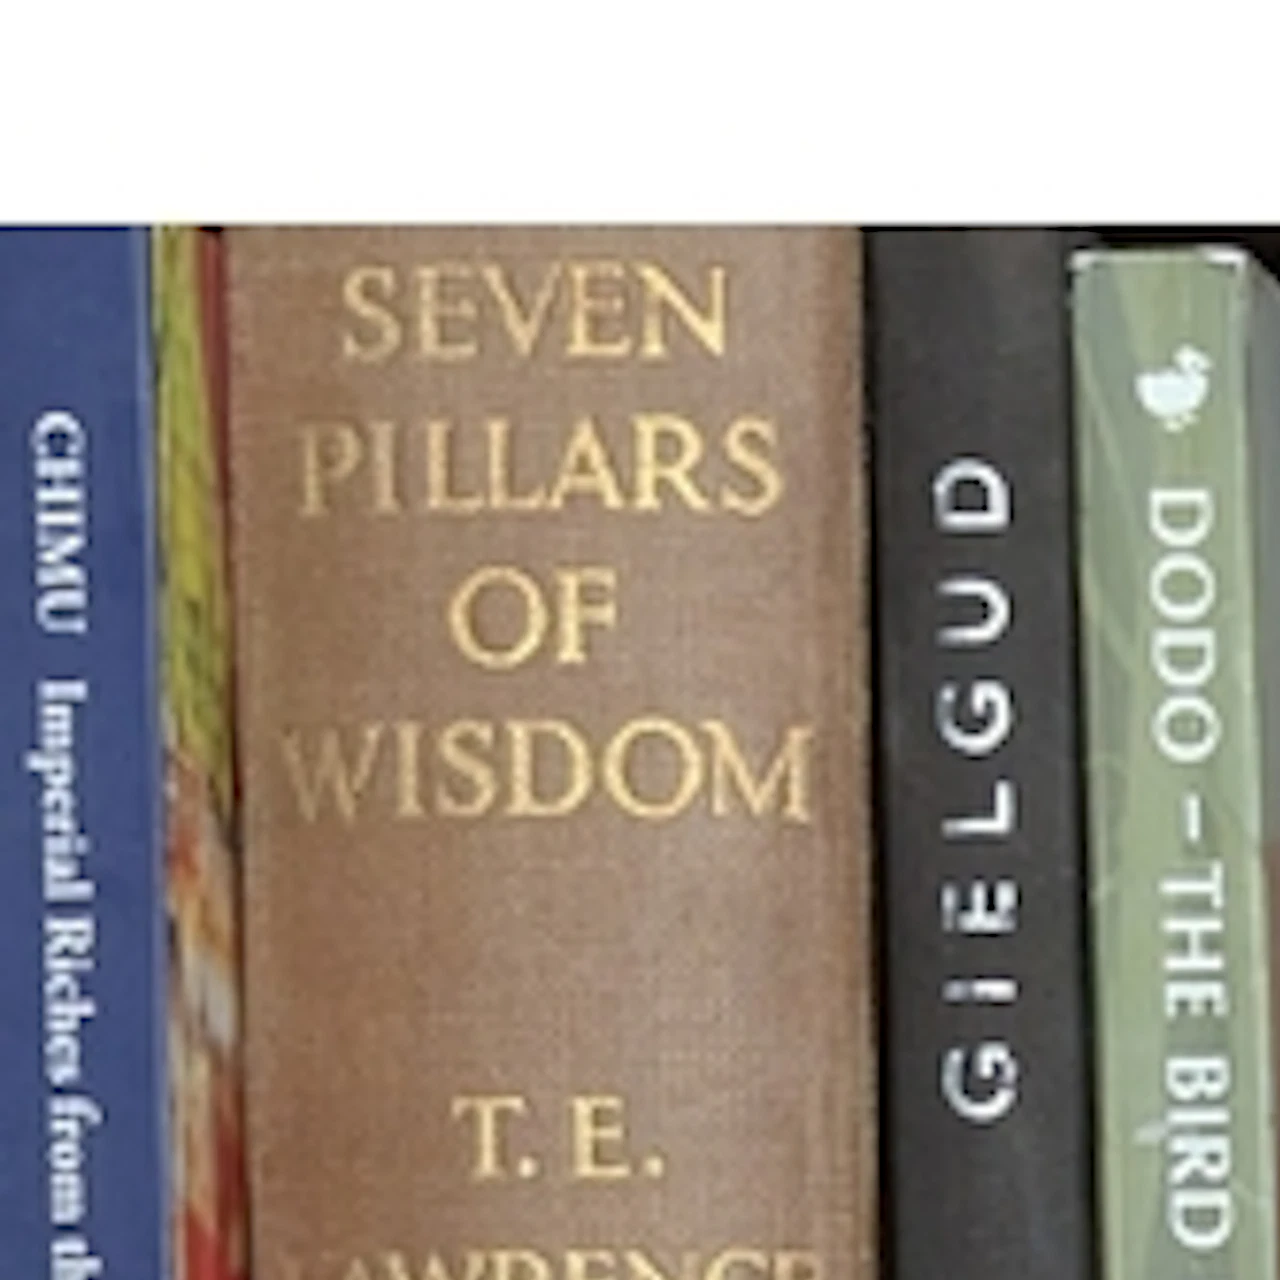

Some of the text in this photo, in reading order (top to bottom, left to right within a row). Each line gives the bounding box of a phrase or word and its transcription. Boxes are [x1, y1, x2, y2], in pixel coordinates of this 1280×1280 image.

[341, 260, 727, 359] SEVEN
[29, 410, 88, 634] CHIMU
[298, 413, 785, 518] PILLARS
[448, 566, 620, 669] OF
[1148, 488, 1223, 763] DODO
[26, 679, 94, 903] Imperial
[280, 716, 817, 826] WISDOM
[933, 457, 1019, 1121] GIELGUD
[42, 914, 95, 1085] Riches
[1160, 863, 1231, 1018] THE
[48, 1098, 103, 1225] from
[449, 1093, 667, 1182] T. E.
[1163, 1056, 1234, 1252] BIRD
